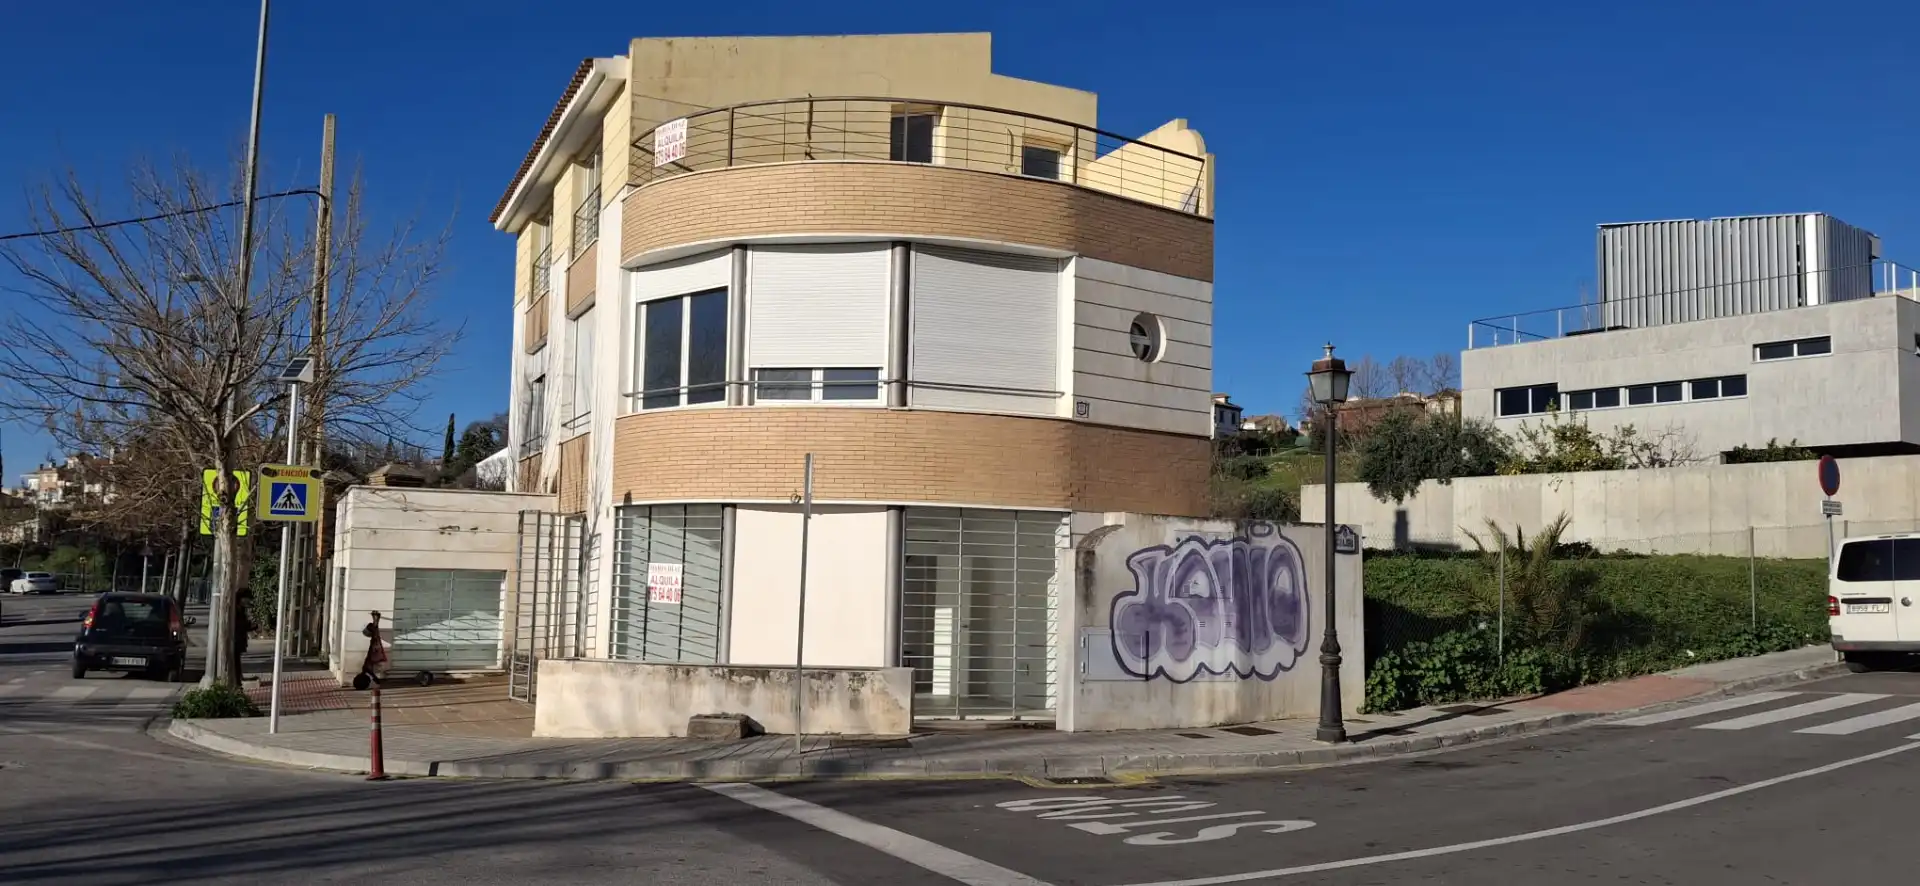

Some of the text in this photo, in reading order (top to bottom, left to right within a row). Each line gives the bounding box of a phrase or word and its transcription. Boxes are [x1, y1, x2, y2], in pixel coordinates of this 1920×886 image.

[658, 132, 684, 148] ALQUILA
[274, 467, 309, 478] TENCIÓN
[651, 575, 680, 586] ALQUILA
[995, 795, 1317, 845] STOP
